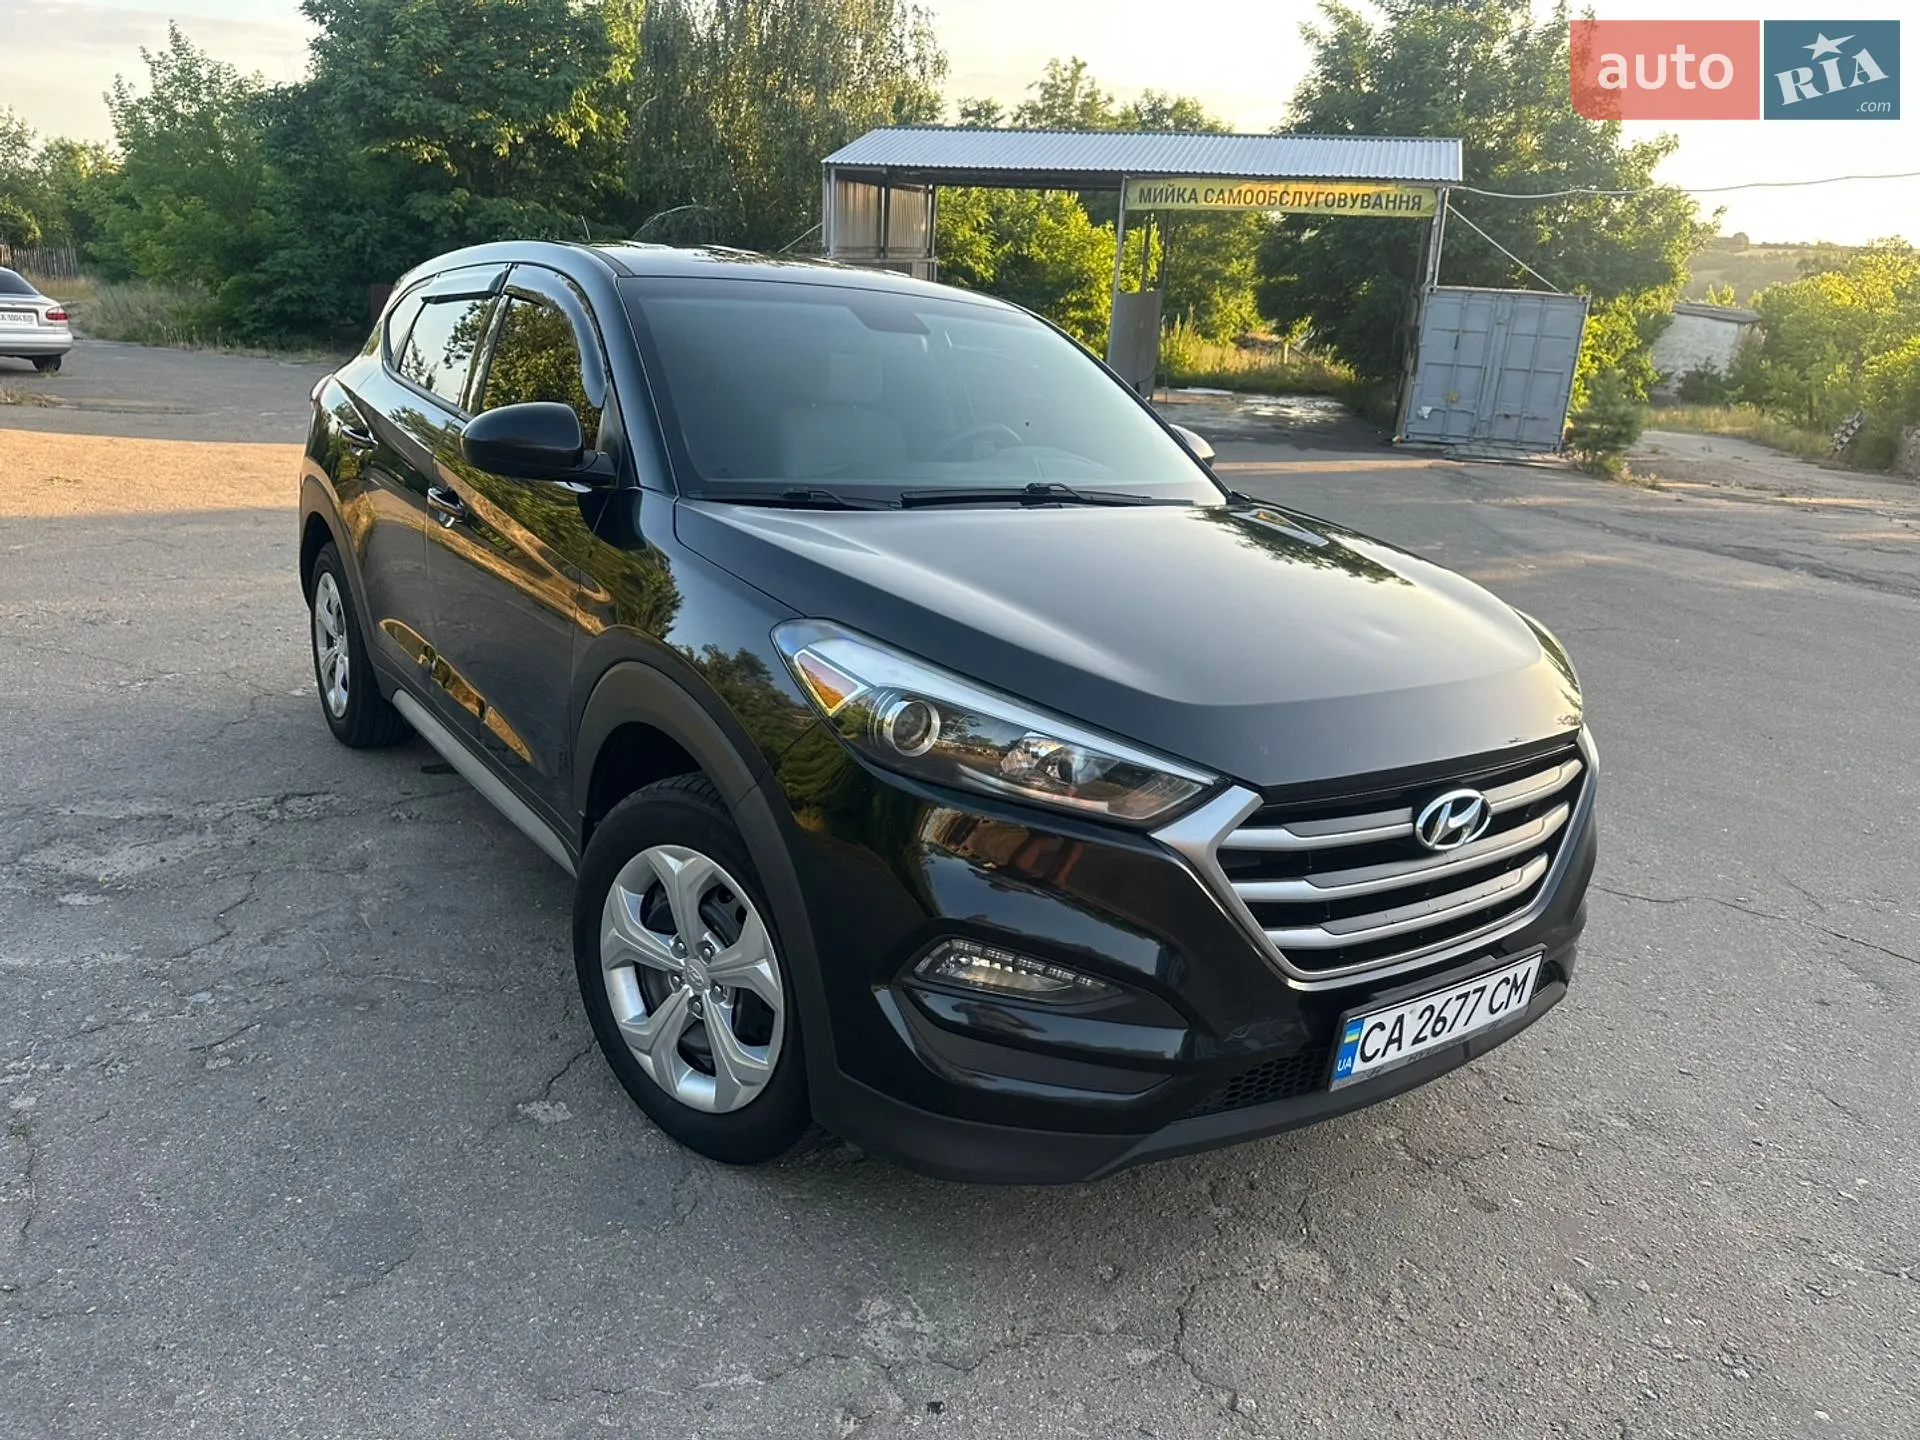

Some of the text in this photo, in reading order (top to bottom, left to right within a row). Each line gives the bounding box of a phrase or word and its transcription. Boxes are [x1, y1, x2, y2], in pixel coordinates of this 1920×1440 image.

[1138, 185, 1422, 211] МИЙКА САМООБСЛУГОВУВАННЯ
[1359, 966, 1532, 1063] CA 2677 CM
[1337, 1056, 1352, 1072] UA
